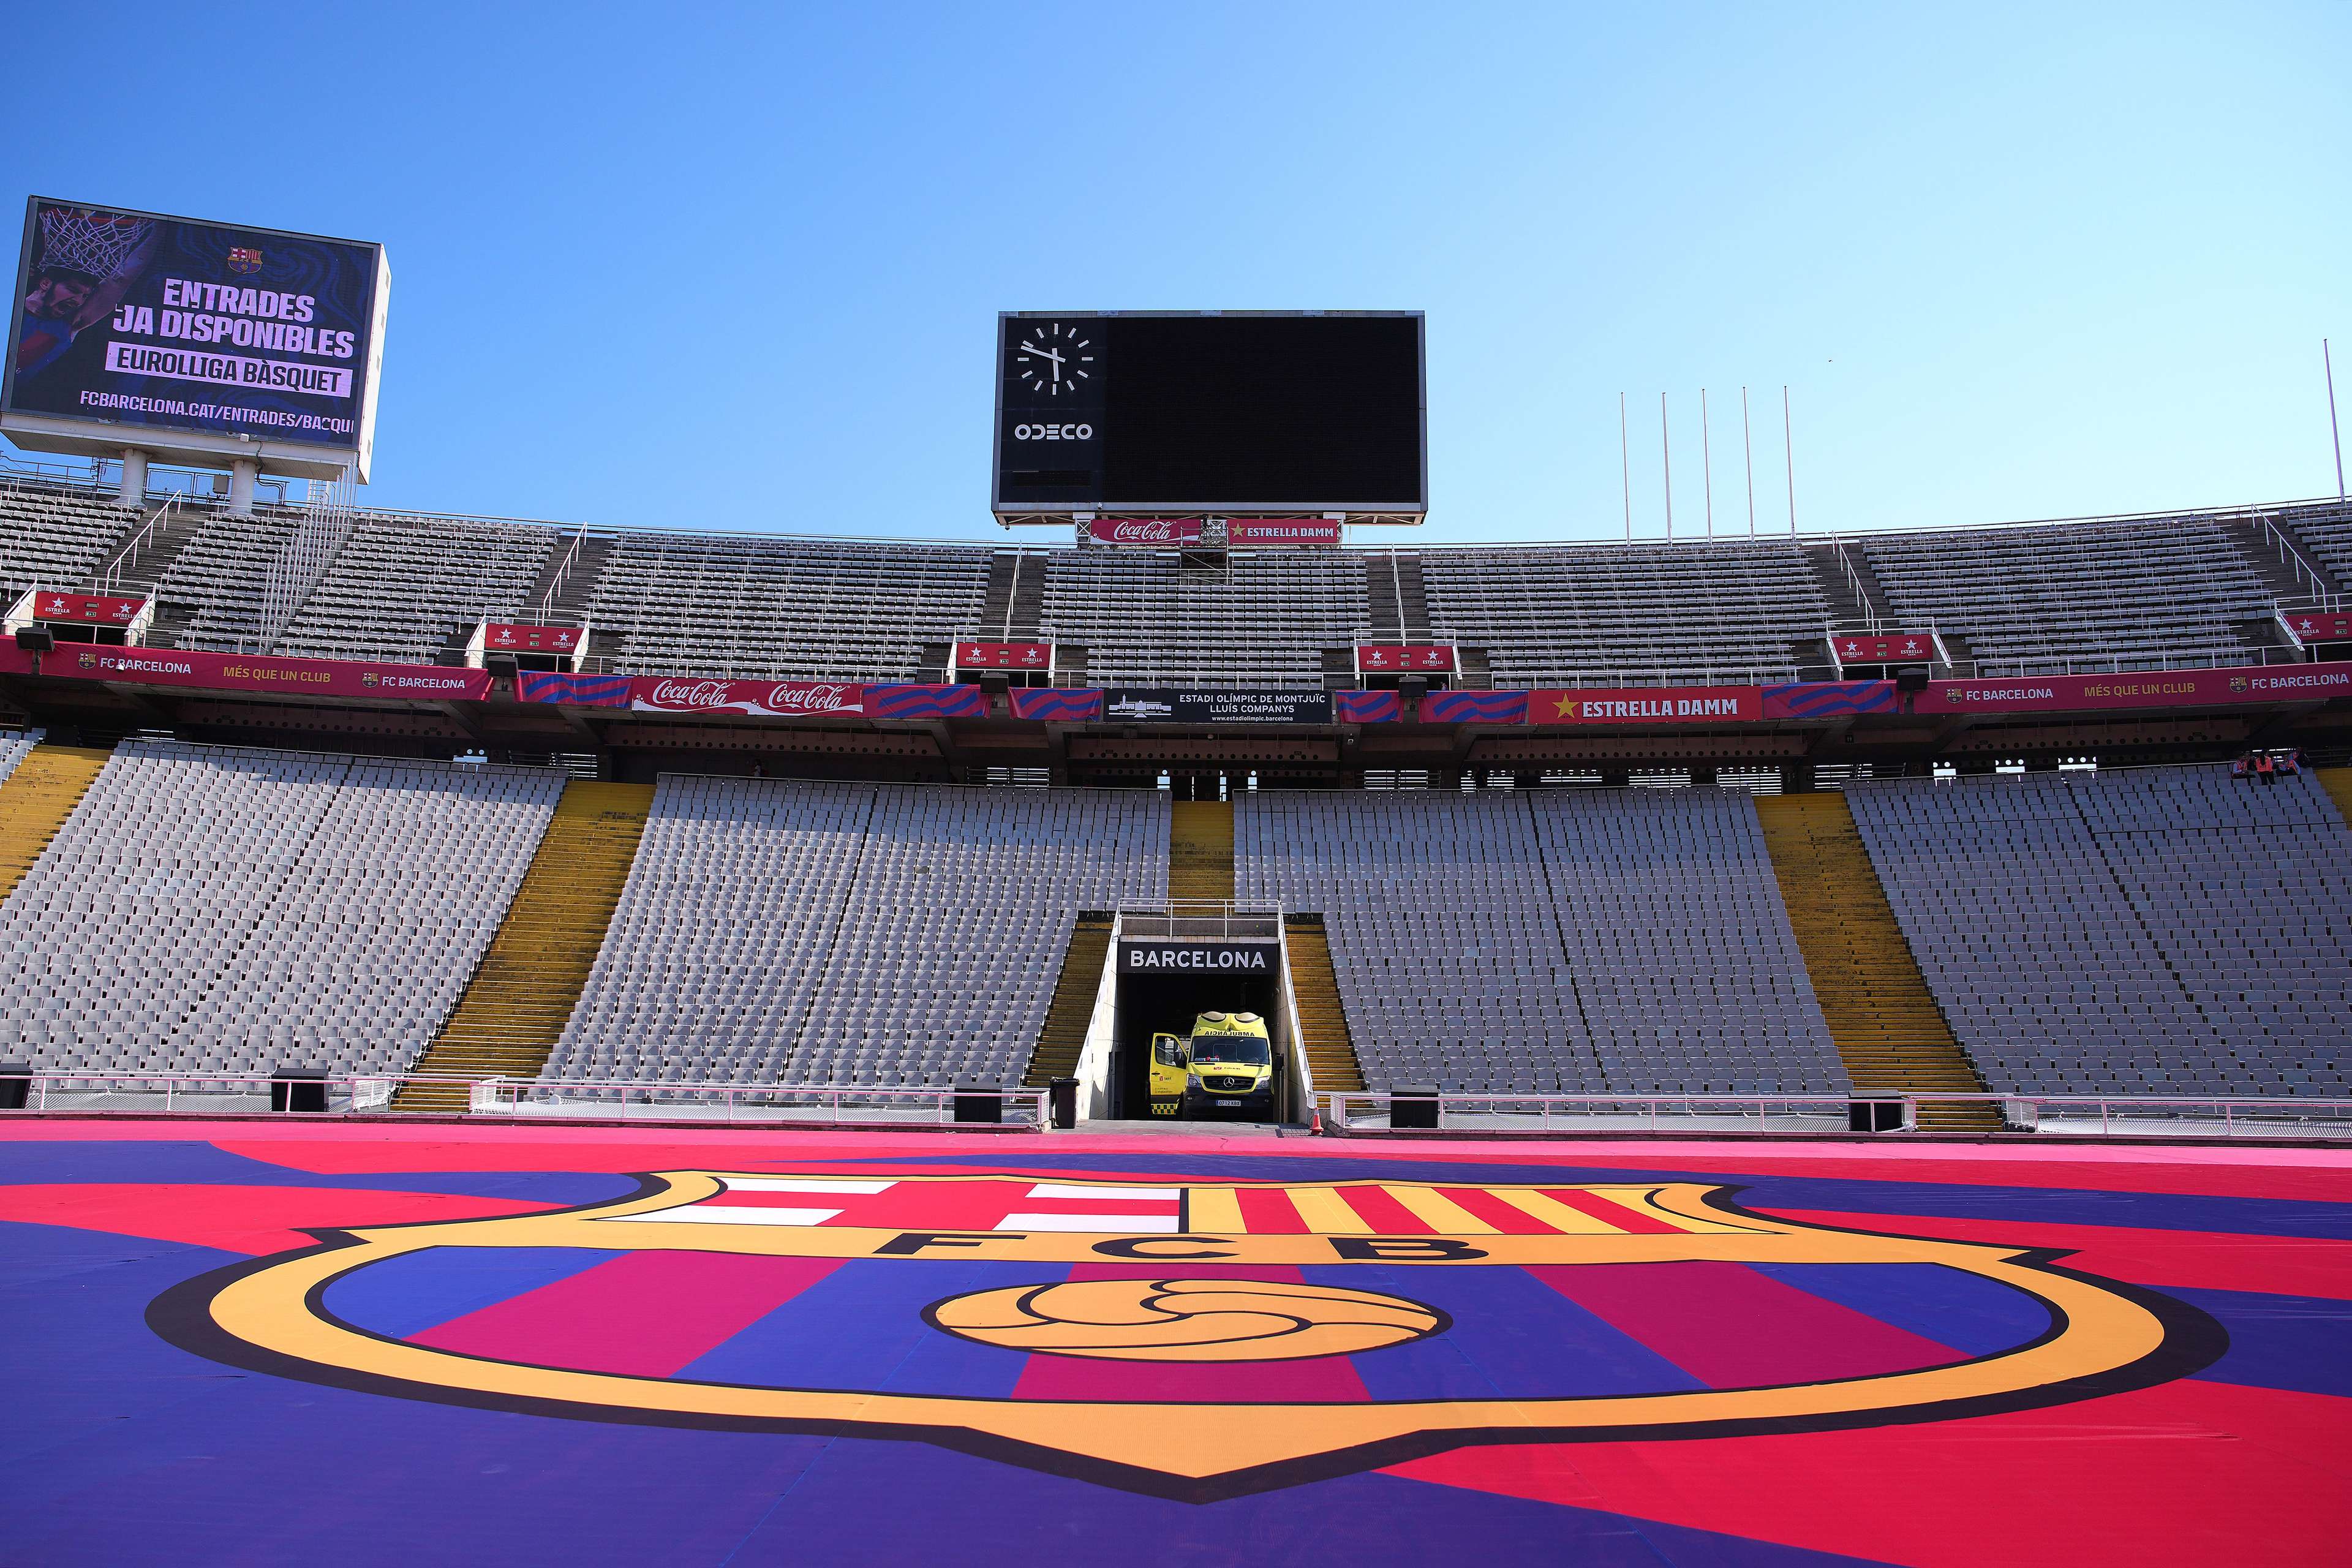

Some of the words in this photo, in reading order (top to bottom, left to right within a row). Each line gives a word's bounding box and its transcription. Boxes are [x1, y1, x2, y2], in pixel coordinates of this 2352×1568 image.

[163, 278, 315, 323] ENTRADES
[113, 304, 156, 335] JA
[160, 309, 355, 359] DISPONIBLES
[117, 347, 237, 382] EUROLLIGA
[244, 360, 342, 393] BÀSQUET
[1014, 423, 1093, 440] ODECO
[1114, 521, 1175, 540] Coca-Cola
[1247, 528, 1298, 537] ESTRELLA
[1300, 528, 1334, 537] DAMM
[100, 657, 115, 668] FC
[118, 658, 191, 674] BARCELONA
[224, 665, 249, 677] MÉS
[253, 669, 277, 680] QUE
[281, 671, 298, 681] UN
[300, 672, 331, 682] CLUB
[382, 676, 396, 687] FC
[398, 677, 466, 688] BARCELONA
[2084, 684, 2110, 697] MÉS
[2114, 685, 2138, 696] QUE
[2142, 684, 2160, 694] UN
[2163, 683, 2195, 693] CLUB
[2252, 679, 2267, 689] FC
[2271, 674, 2349, 688] BARCELONA
[652, 680, 733, 706] Coca-Cola
[768, 684, 846, 709] Coca-Cola
[1217, 693, 1257, 703] OLÍMPIC
[1275, 693, 1325, 703] MONTJUÏC
[1966, 690, 1980, 701] FC
[1983, 688, 2053, 700] BARCELONA
[1210, 703, 1238, 712] LLUÍS
[1582, 700, 1673, 717] ESTRELLA
[1678, 699, 1738, 715] DAMM
[1131, 951, 1265, 968] BARCELONA
